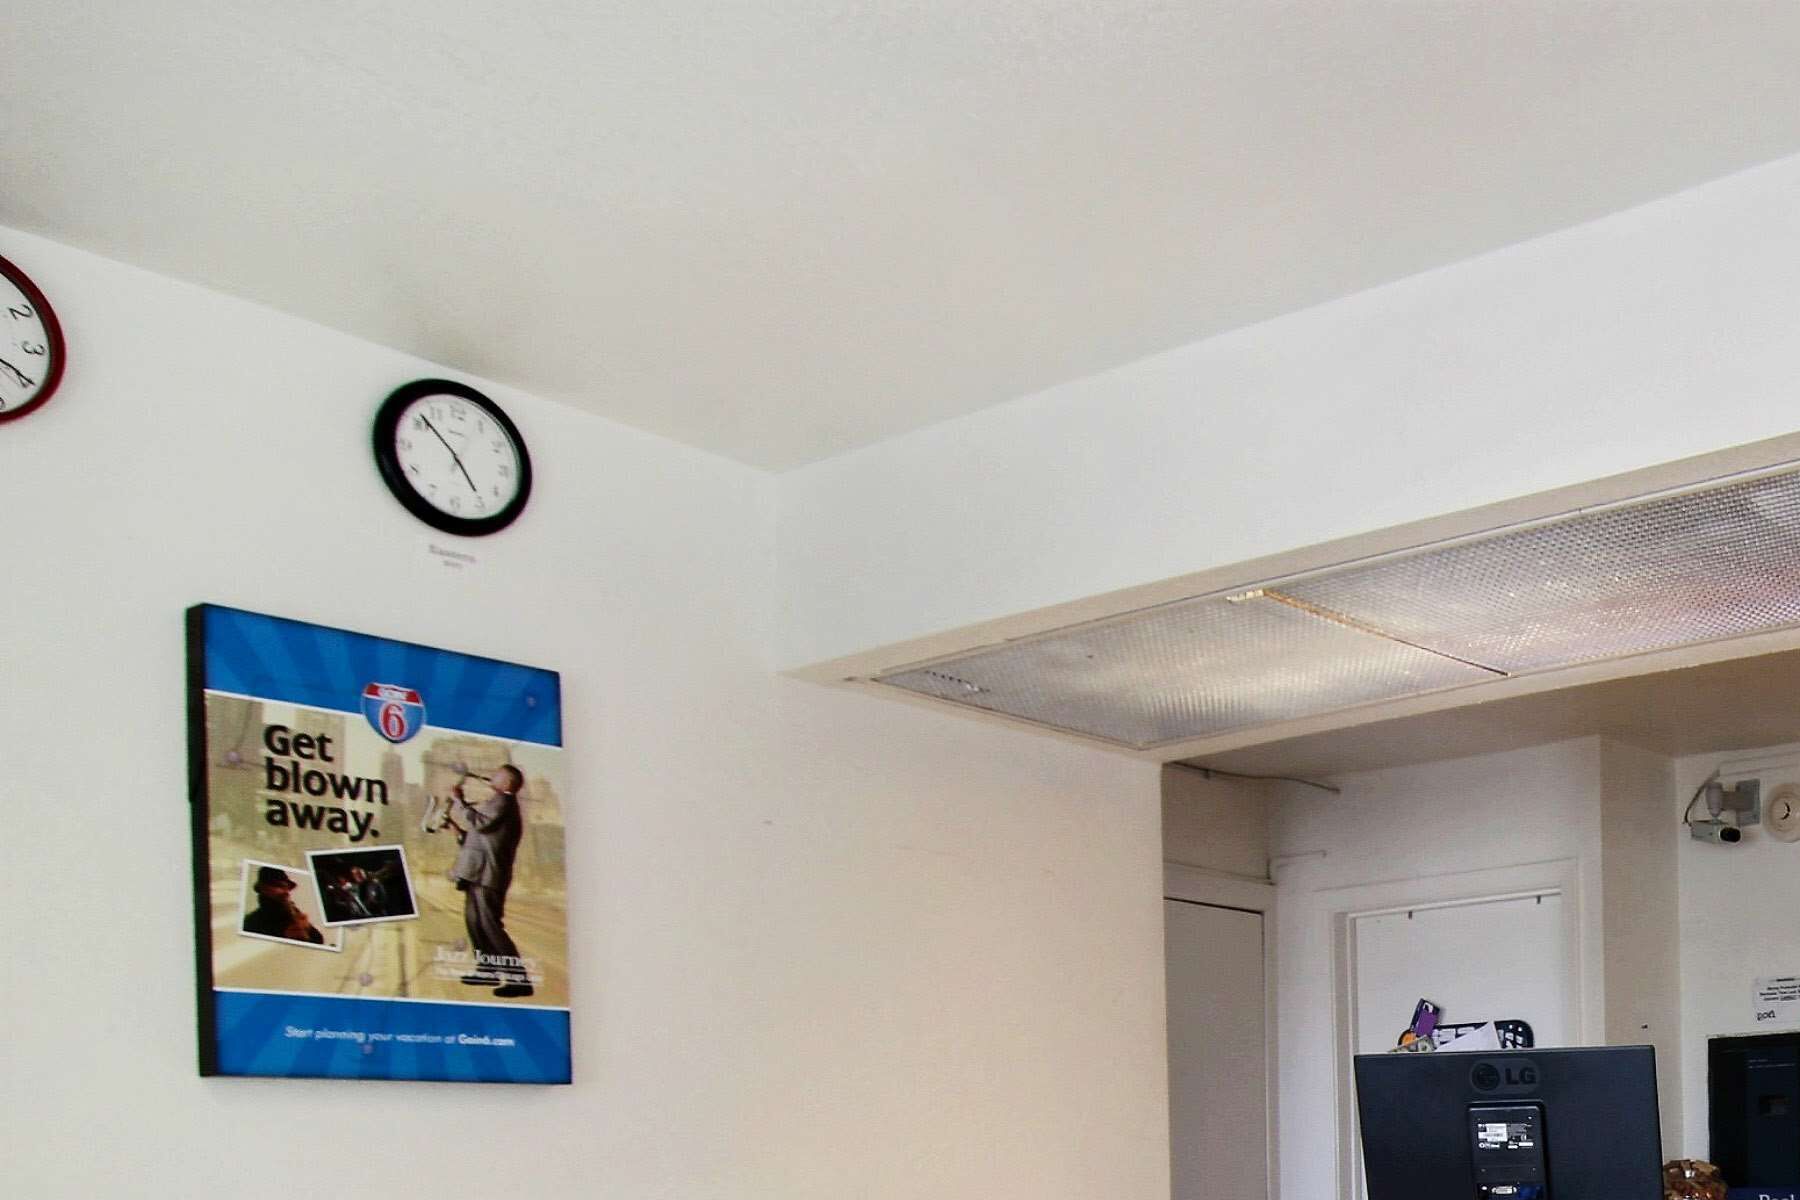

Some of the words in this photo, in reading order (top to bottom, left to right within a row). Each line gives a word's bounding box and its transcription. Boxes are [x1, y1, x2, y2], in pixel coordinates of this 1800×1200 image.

[380, 702, 407, 740] 6
[264, 725, 334, 762] Get
[265, 756, 389, 806] blown
[265, 800, 380, 842] away.
[315, 1028, 366, 1043] planning
[368, 1032, 393, 1042] your
[396, 1033, 441, 1043] vacation
[1505, 1067, 1537, 1085] LG
